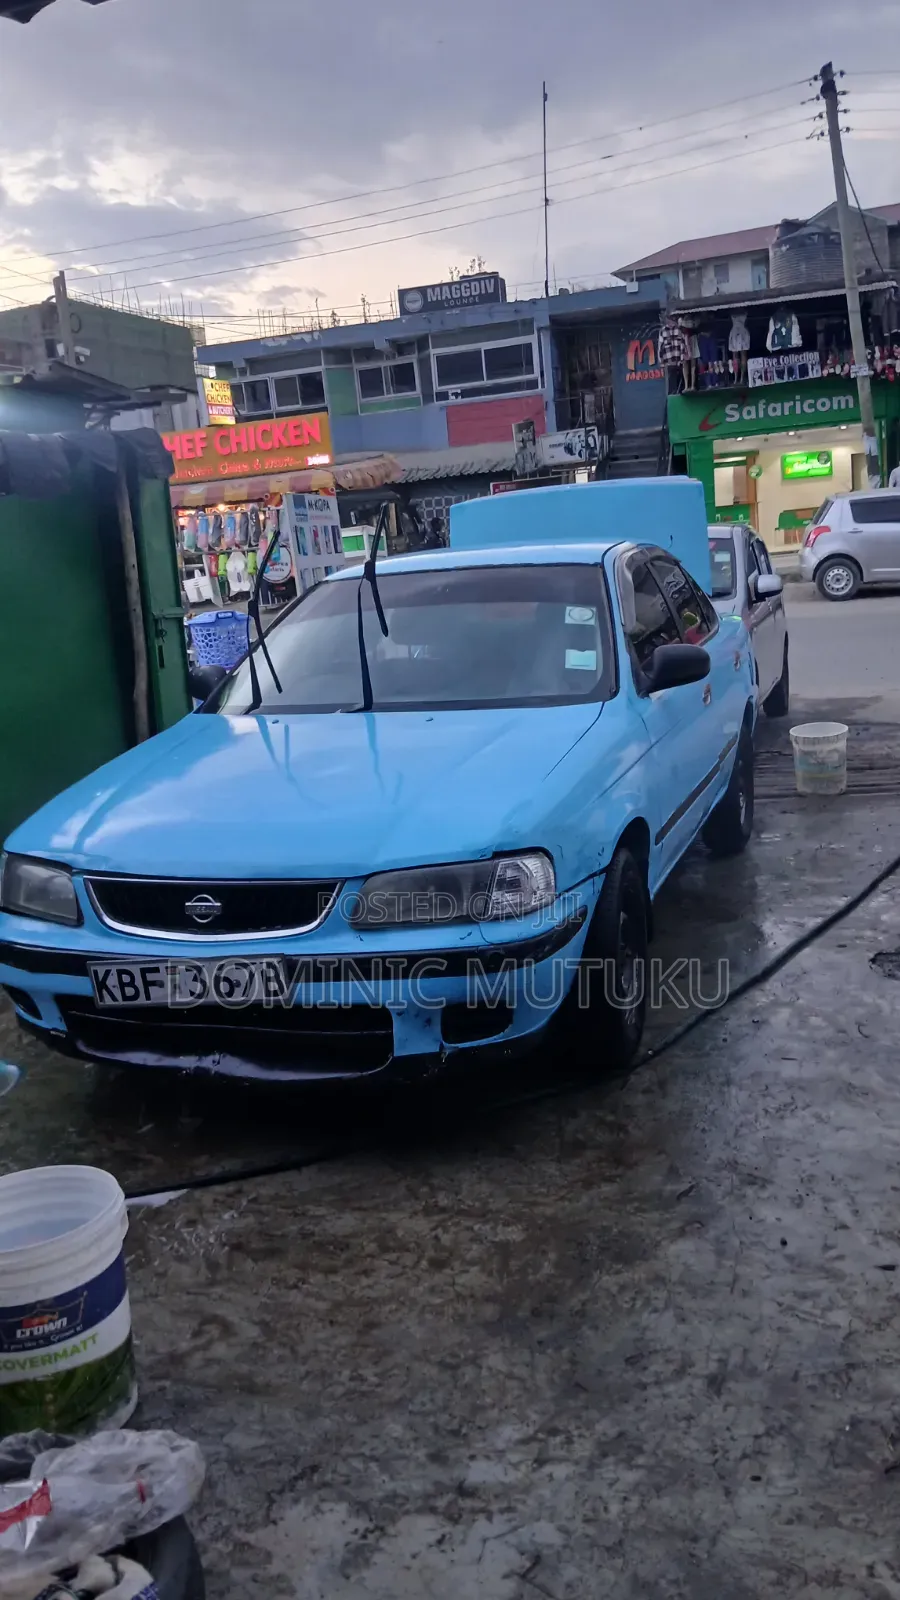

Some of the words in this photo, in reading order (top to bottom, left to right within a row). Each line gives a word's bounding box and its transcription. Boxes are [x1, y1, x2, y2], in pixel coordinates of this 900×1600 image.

[426, 279, 495, 302] MAGGDIV
[444, 296, 480, 307] LOUNGE
[779, 351, 820, 366] Collection
[206, 393, 232, 404] CHICKEN
[214, 382, 230, 393] CHEF
[725, 394, 854, 424] Safaricom
[214, 417, 321, 456] CHICKEN
[93, 965, 161, 1003] KBF
[16, 1317, 68, 1339] crown
